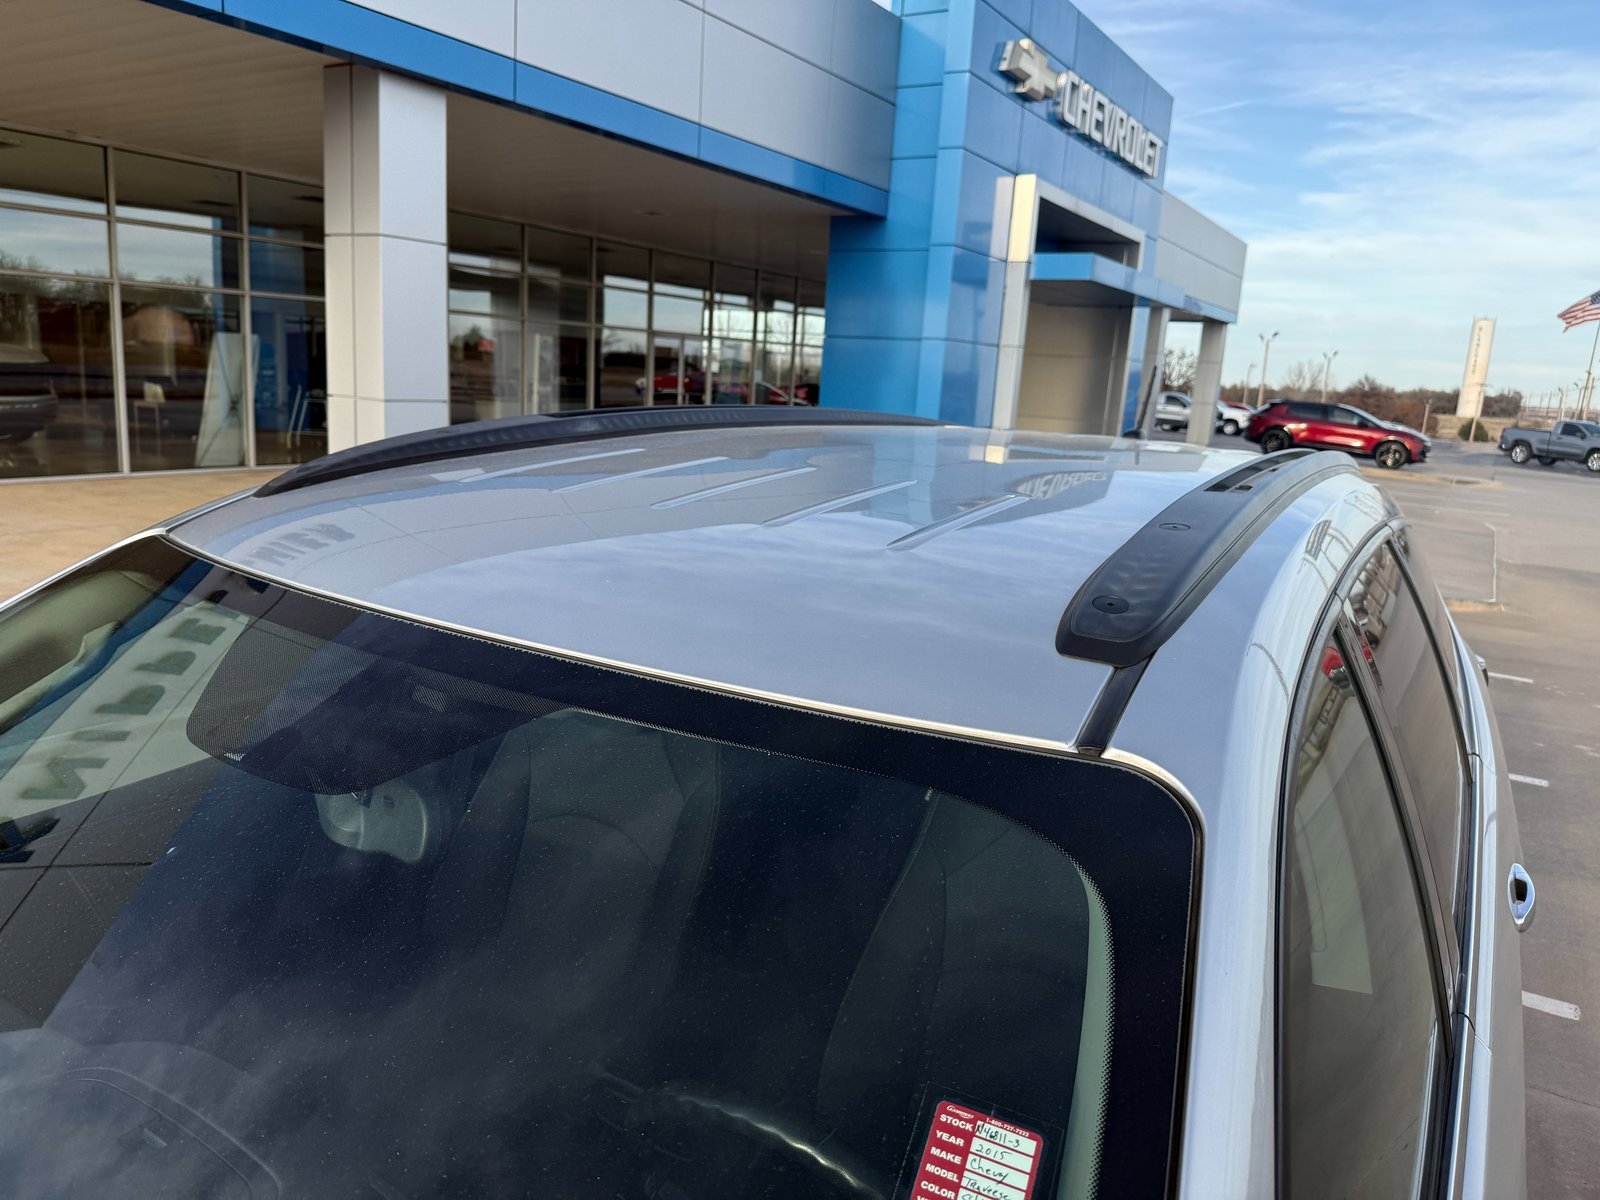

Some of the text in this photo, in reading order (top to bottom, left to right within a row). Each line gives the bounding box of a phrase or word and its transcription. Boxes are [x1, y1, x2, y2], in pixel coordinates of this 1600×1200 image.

[1056, 70, 1164, 178] CHEVROLET
[939, 1113, 974, 1132] STOCK
[935, 1129, 965, 1147] YEAR
[930, 1146, 963, 1165] MAKE
[975, 1143, 1012, 1161] 2015
[925, 1163, 959, 1183] MODEL
[920, 1180, 956, 1200] COLOR
